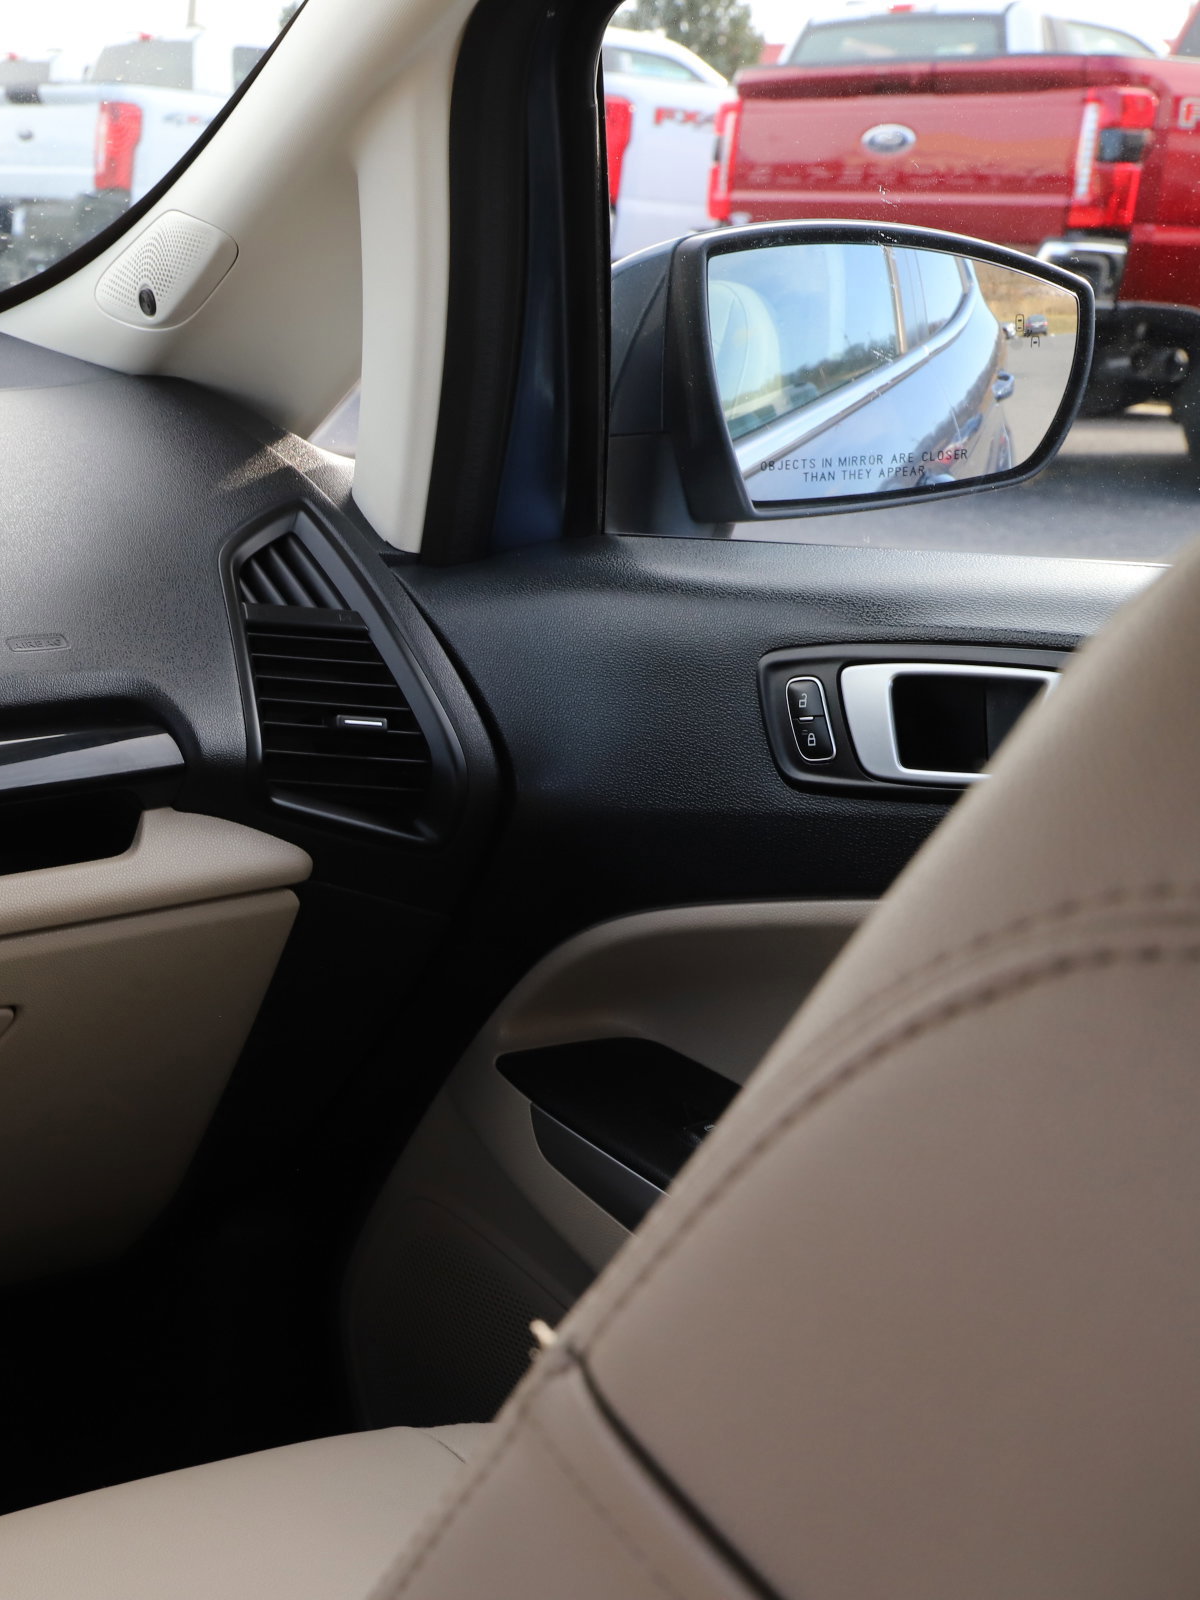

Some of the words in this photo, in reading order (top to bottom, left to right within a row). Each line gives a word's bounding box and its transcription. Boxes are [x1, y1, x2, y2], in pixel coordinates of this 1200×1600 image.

[760, 459, 816, 472] OBJECTS
[822, 458, 832, 468] IN
[838, 455, 884, 466] MIRROR
[891, 454, 914, 463] ARE
[922, 449, 968, 462] CLOSER
[804, 472, 835, 482] THAN
[843, 468, 872, 480] THEY
[878, 466, 925, 478] APPEAR
